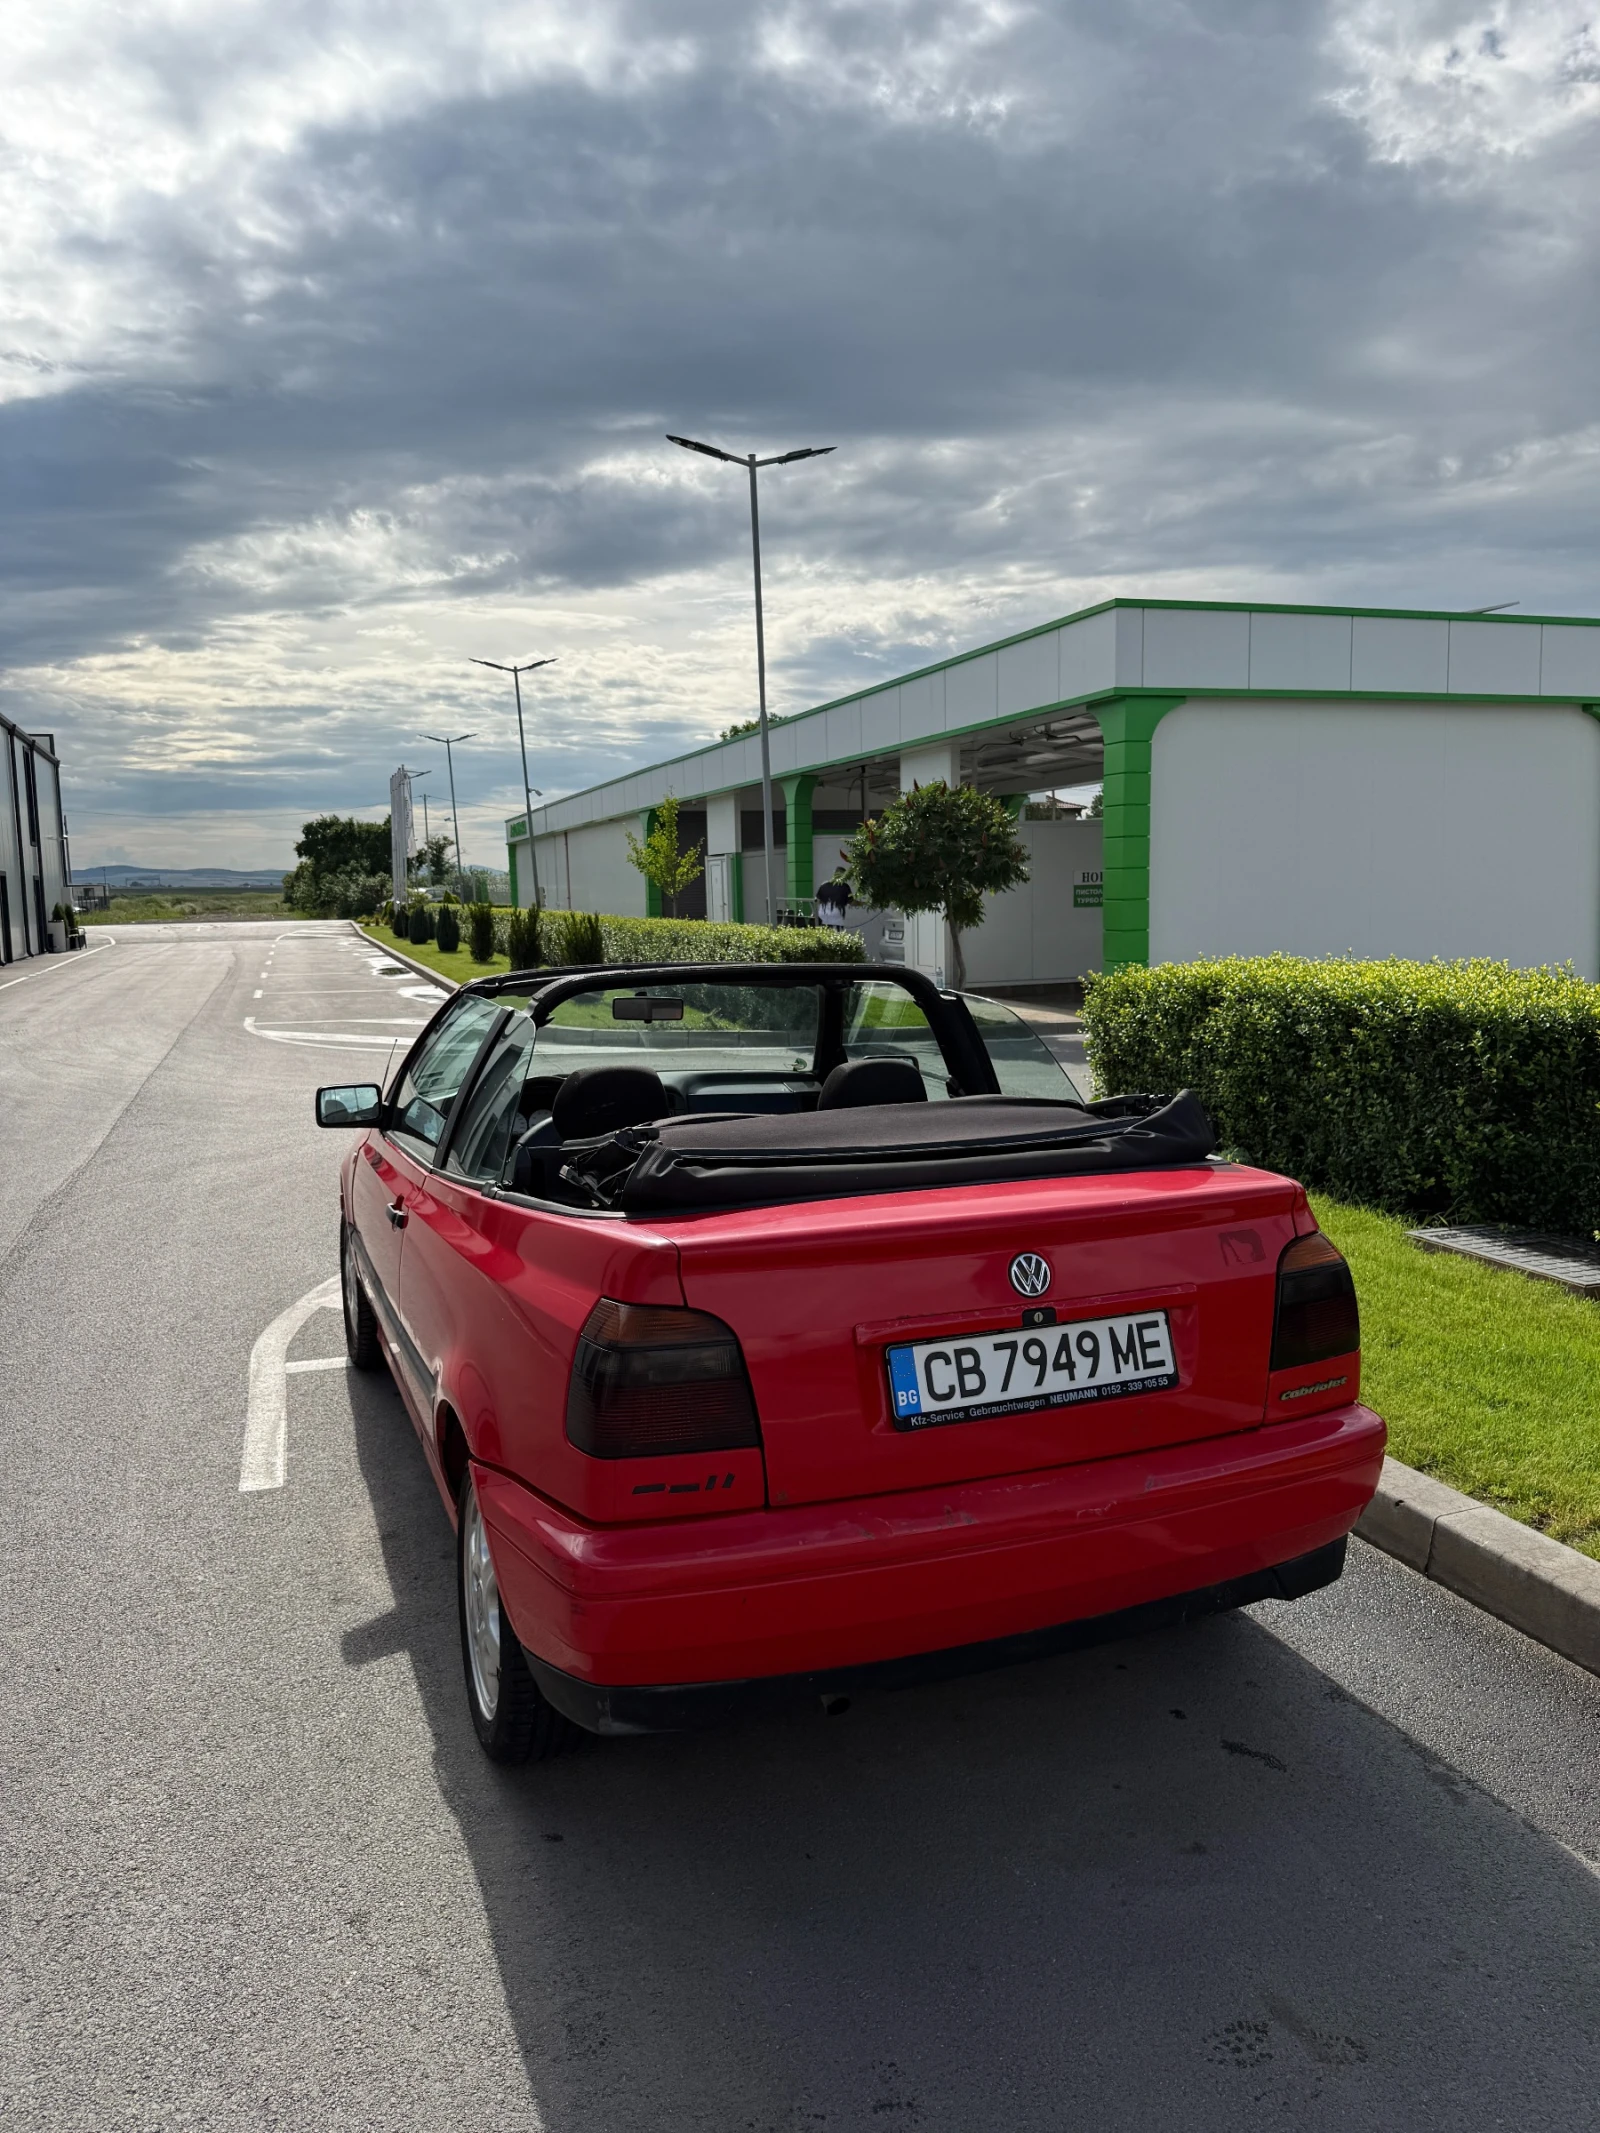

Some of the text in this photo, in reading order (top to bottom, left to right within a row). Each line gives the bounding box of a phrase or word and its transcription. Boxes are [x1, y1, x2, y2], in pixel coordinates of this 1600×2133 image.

[1012, 1253, 1050, 1296] VW
[924, 1320, 1166, 1402] CB 7949 ME
[898, 1390, 918, 1406] BG
[911, 1411, 965, 1426] Kfz-Service
[969, 1398, 1046, 1417] Gebrauchtwagen
[1049, 1388, 1098, 1404] NEUMANN
[1101, 1384, 1121, 1396] 0152
